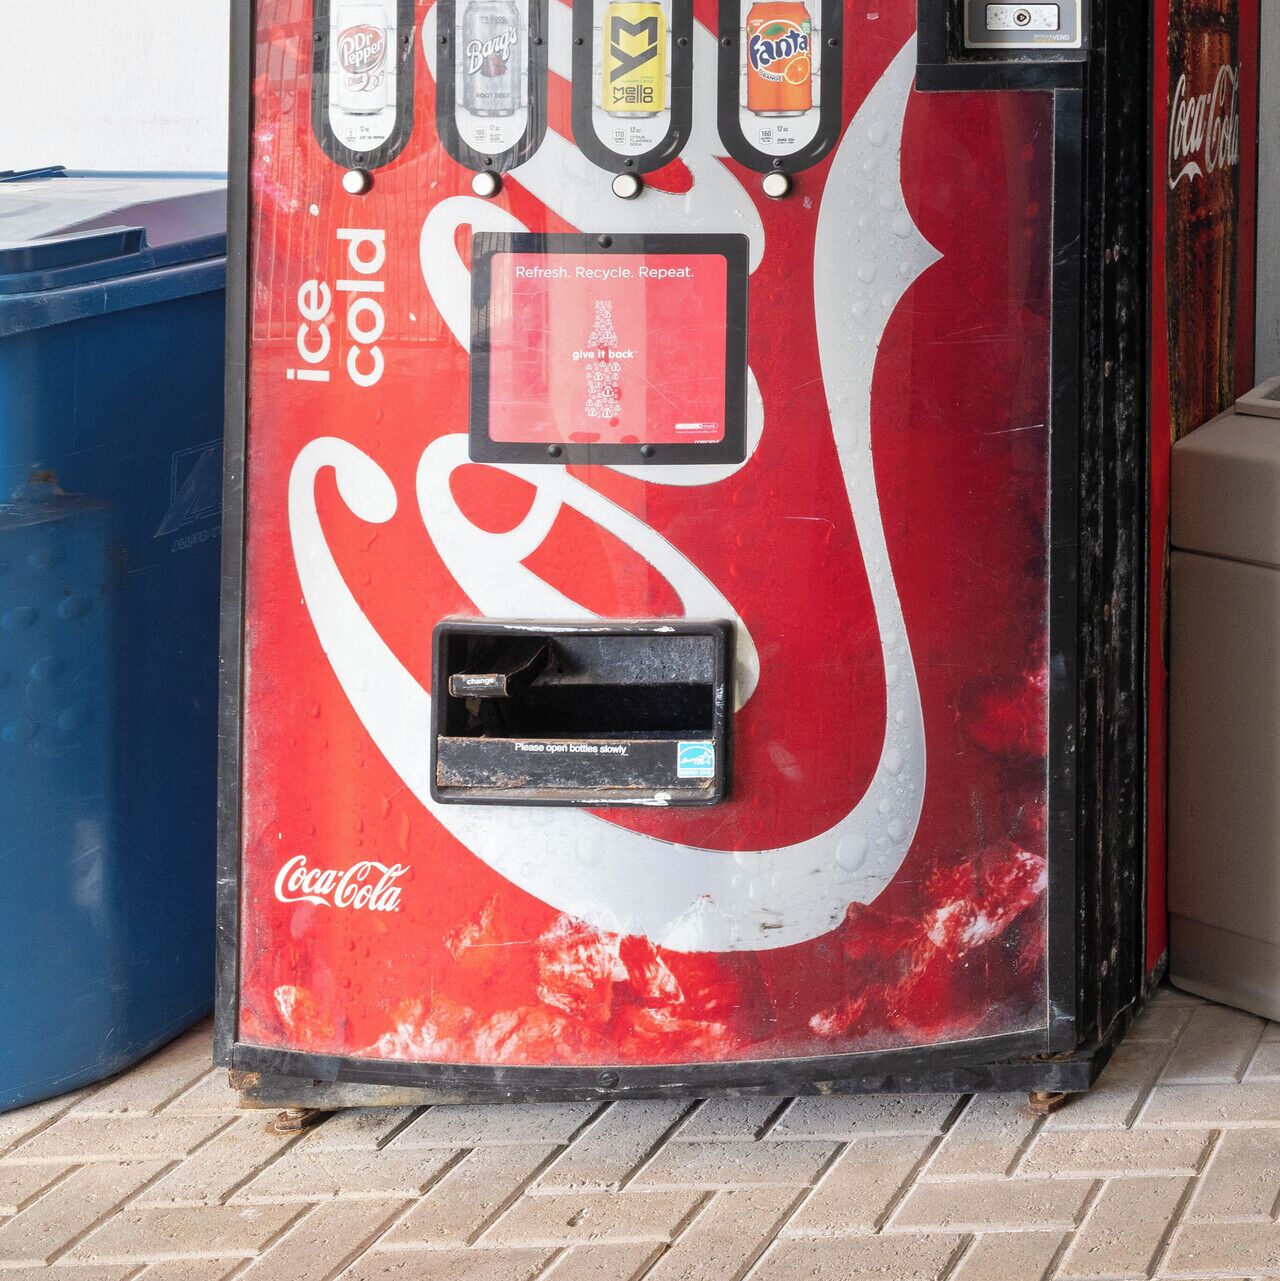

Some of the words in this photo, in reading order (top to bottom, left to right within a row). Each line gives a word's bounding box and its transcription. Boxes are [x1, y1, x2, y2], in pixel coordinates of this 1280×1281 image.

[343, 38, 385, 67] Pepper
[355, 32, 373, 49] Dr
[467, 26, 518, 75] Barq's
[749, 29, 809, 71] Fanta
[759, 70, 783, 82] ORANGE
[1168, 62, 1242, 190] Coca-Cola
[515, 266, 571, 279] Refresh.
[575, 266, 634, 281] Recycle.
[638, 266, 694, 281] Repeat.
[336, 228, 386, 387] cold
[286, 279, 332, 382] ice
[572, 349, 594, 360] give
[597, 348, 606, 359] it
[608, 348, 634, 359] back
[466, 677, 494, 686] change
[514, 742, 544, 753] Please
[545, 743, 568, 754] open
[569, 742, 598, 754] bottles
[600, 744, 627, 755] slowly
[274, 854, 411, 912] Coca-Cola
